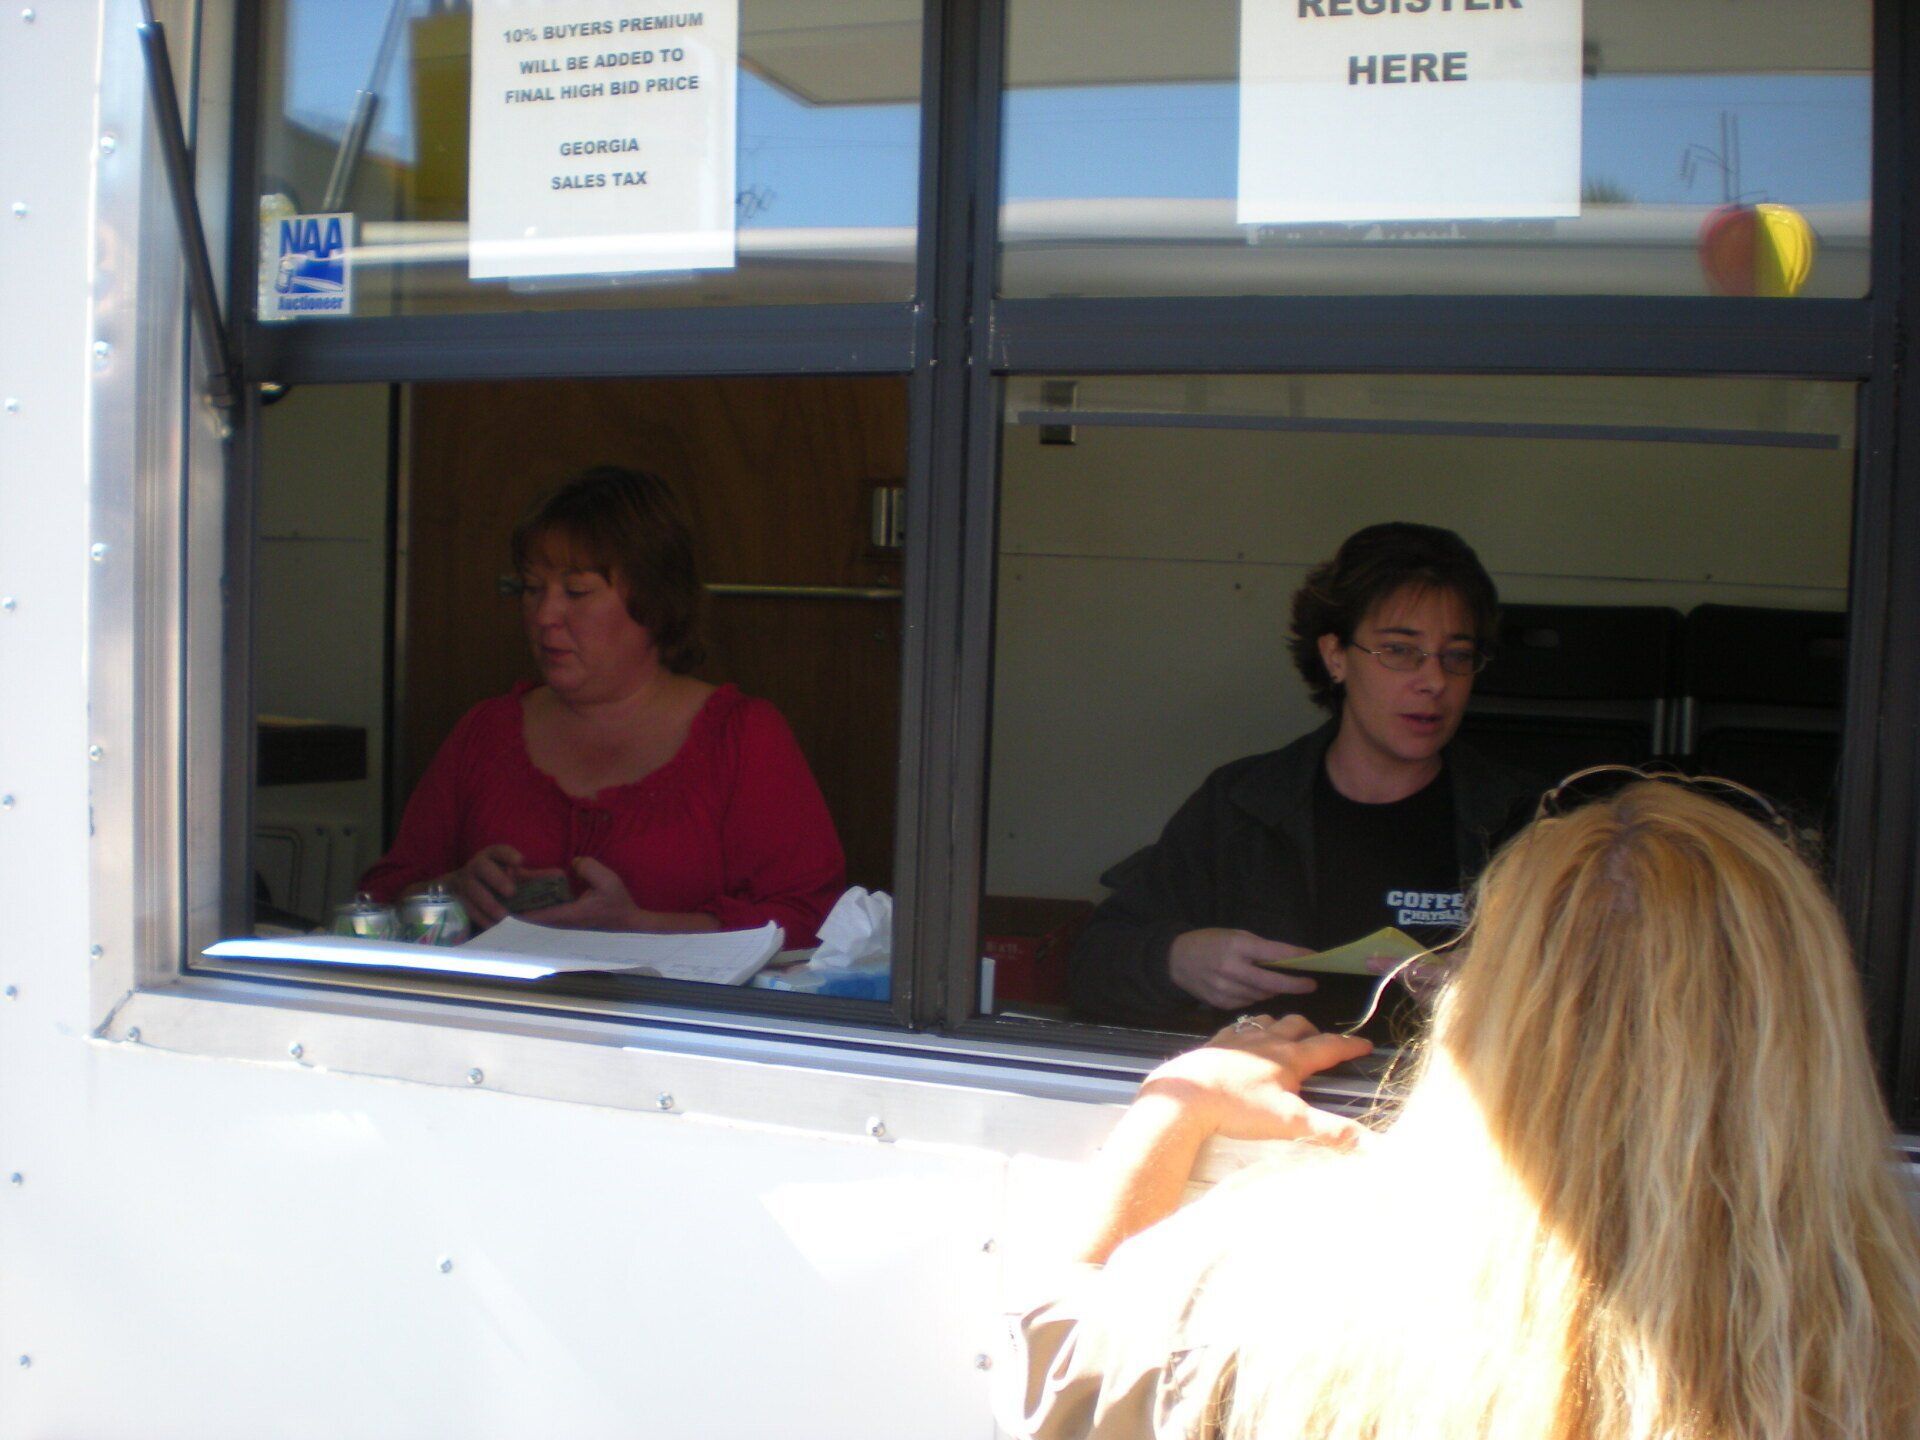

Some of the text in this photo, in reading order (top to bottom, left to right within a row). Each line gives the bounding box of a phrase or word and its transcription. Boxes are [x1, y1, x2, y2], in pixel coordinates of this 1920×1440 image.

[1297, 0, 1522, 18] REGIS
[503, 12, 704, 43] 10% BUYERS PREMIUM
[520, 48, 684, 75] WILL BE ADDED TO
[1348, 51, 1468, 86] HERE
[505, 76, 699, 104] FINAL HIGH BID PRICE
[559, 137, 640, 156] GEORGIA
[551, 171, 648, 190] SALES TAX
[280, 217, 344, 258] NAA
